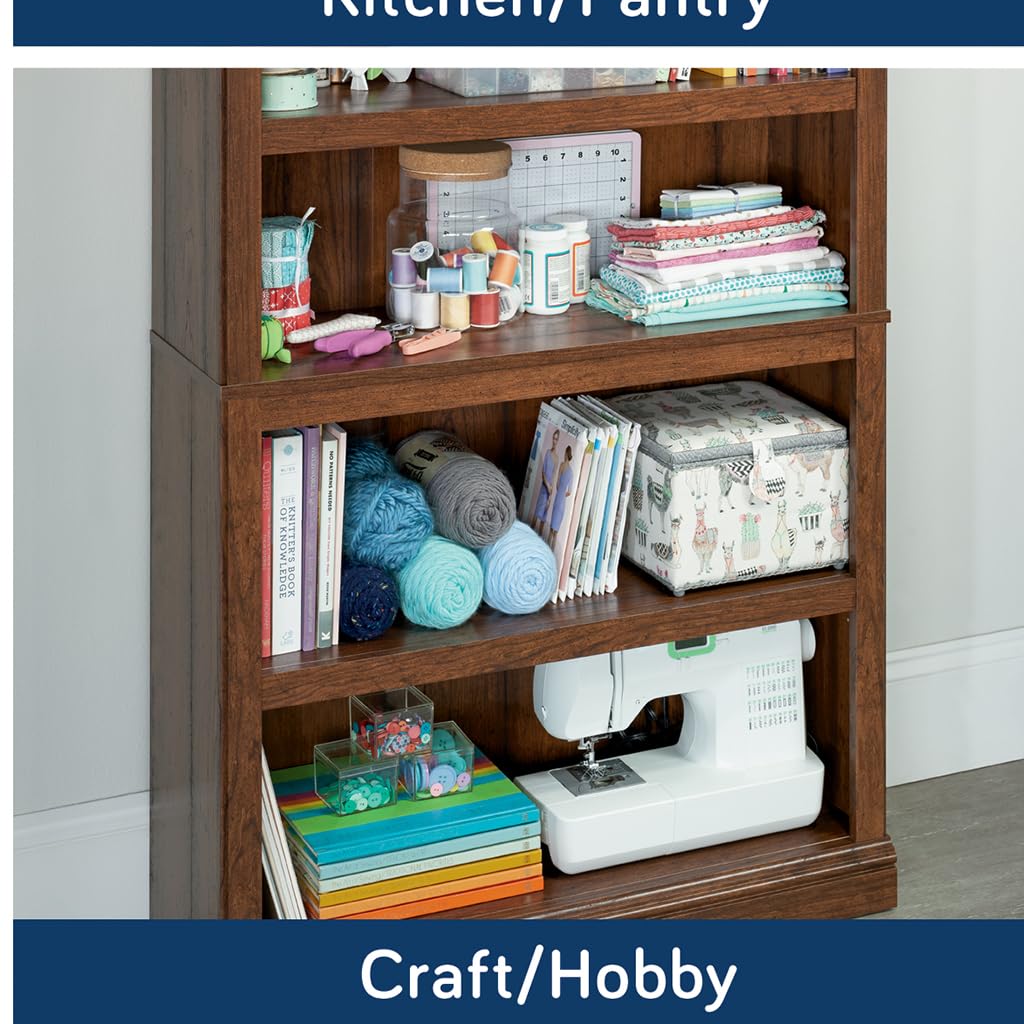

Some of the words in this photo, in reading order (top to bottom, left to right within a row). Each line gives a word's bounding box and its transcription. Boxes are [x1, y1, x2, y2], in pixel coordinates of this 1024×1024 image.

[542, 154, 548, 162] 6
[595, 149, 601, 157] 9
[610, 148, 620, 156] 10
[328, 450, 334, 460] NO
[279, 507, 287, 522] OF
[279, 526, 287, 599] KNOWLEDGE
